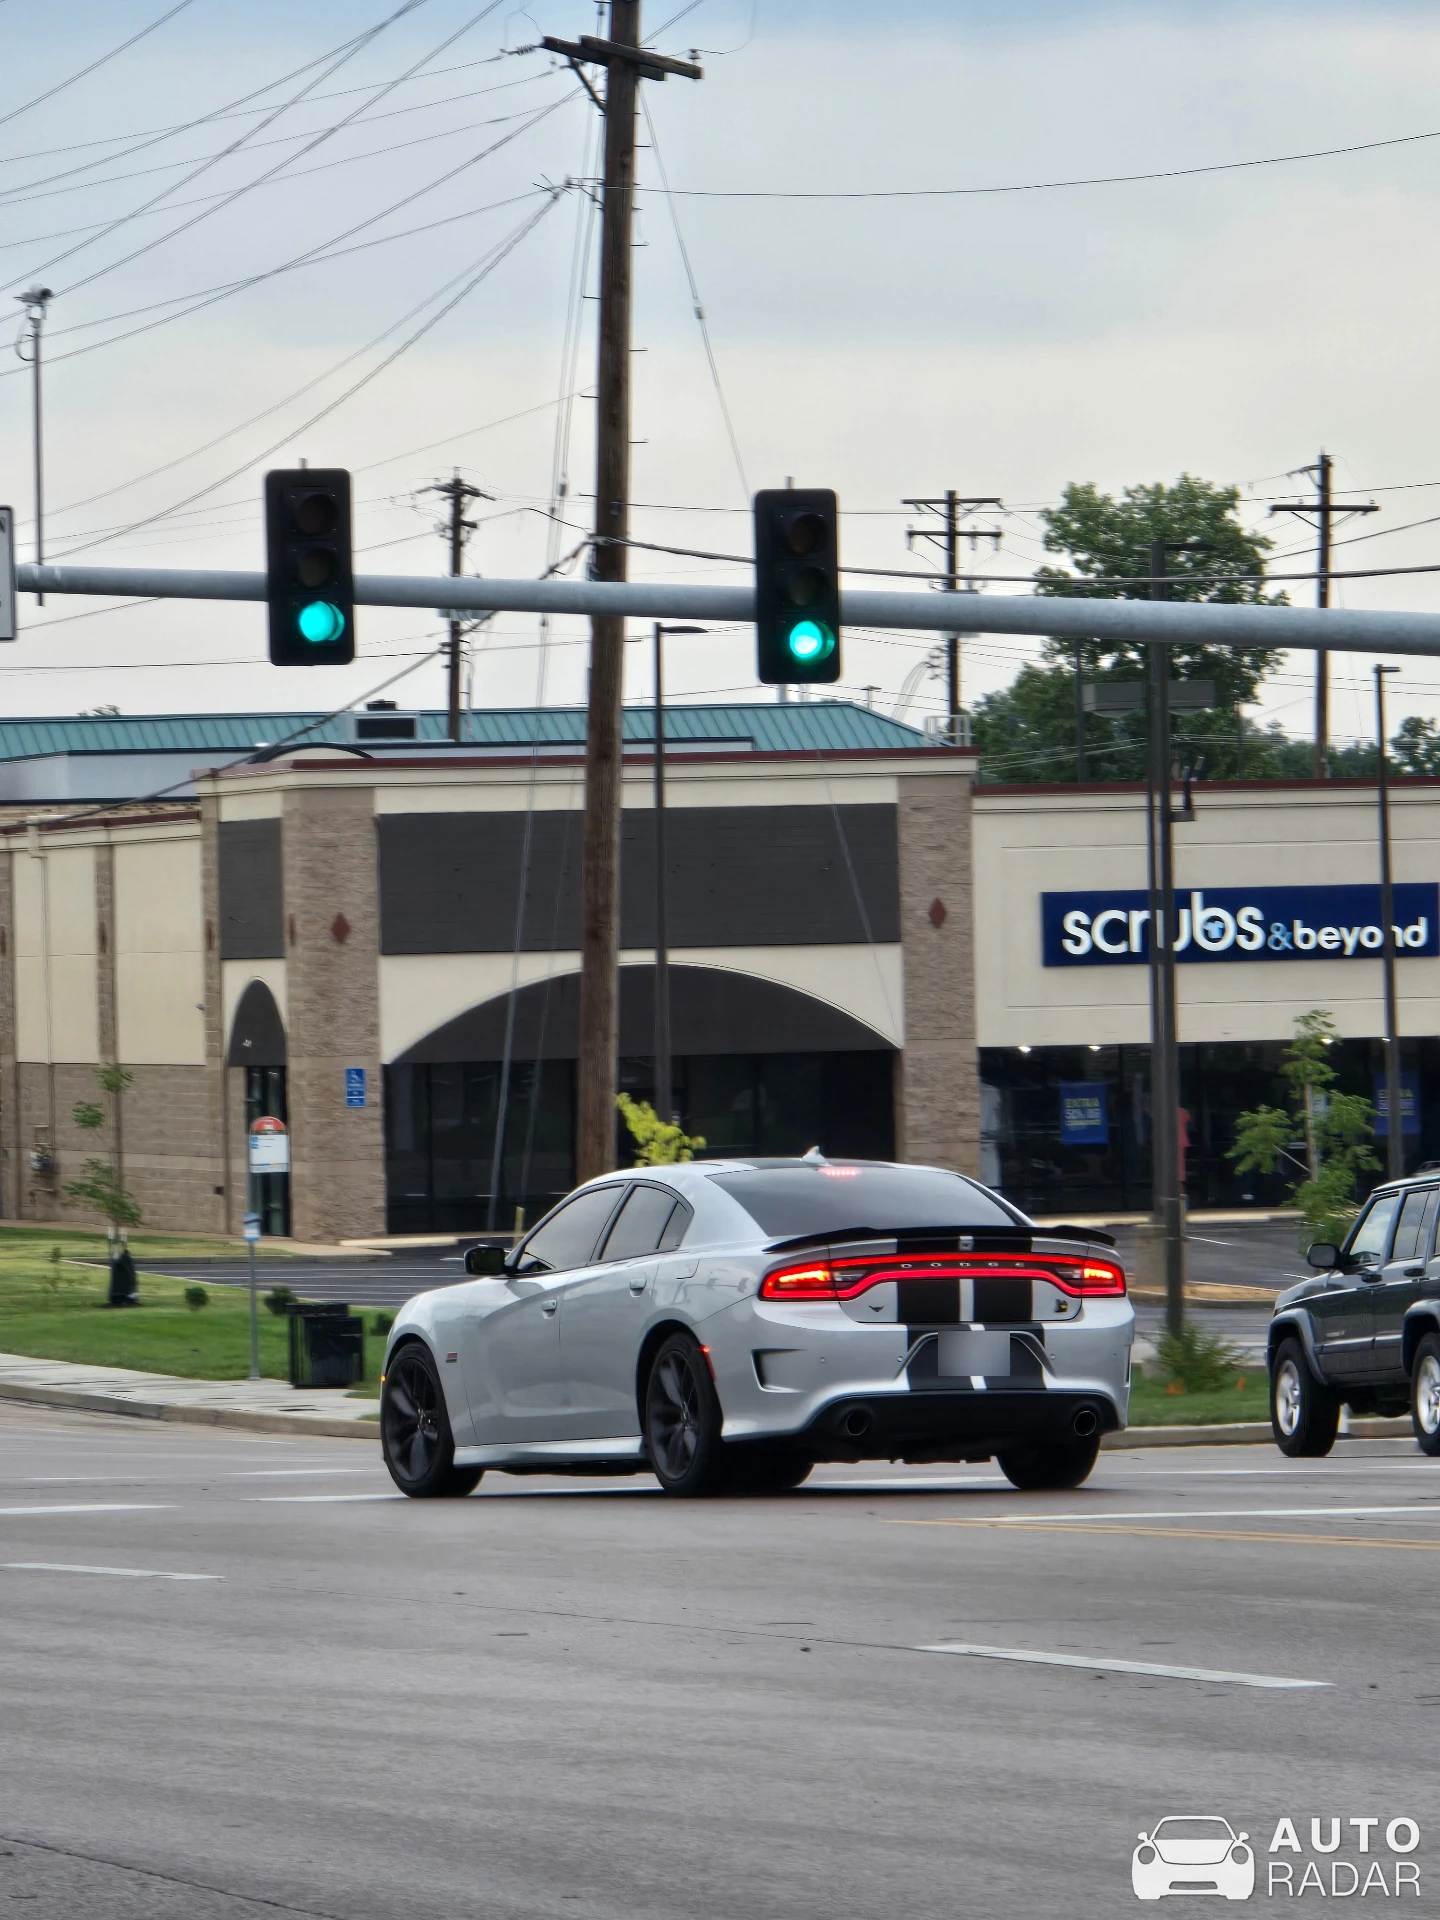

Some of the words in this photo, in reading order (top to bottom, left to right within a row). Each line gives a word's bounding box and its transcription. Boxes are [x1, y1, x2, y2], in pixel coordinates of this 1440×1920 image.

[1062, 892, 1264, 954] scrubs
[1293, 916, 1428, 955] beyond
[900, 1261, 1025, 1269] DODGE
